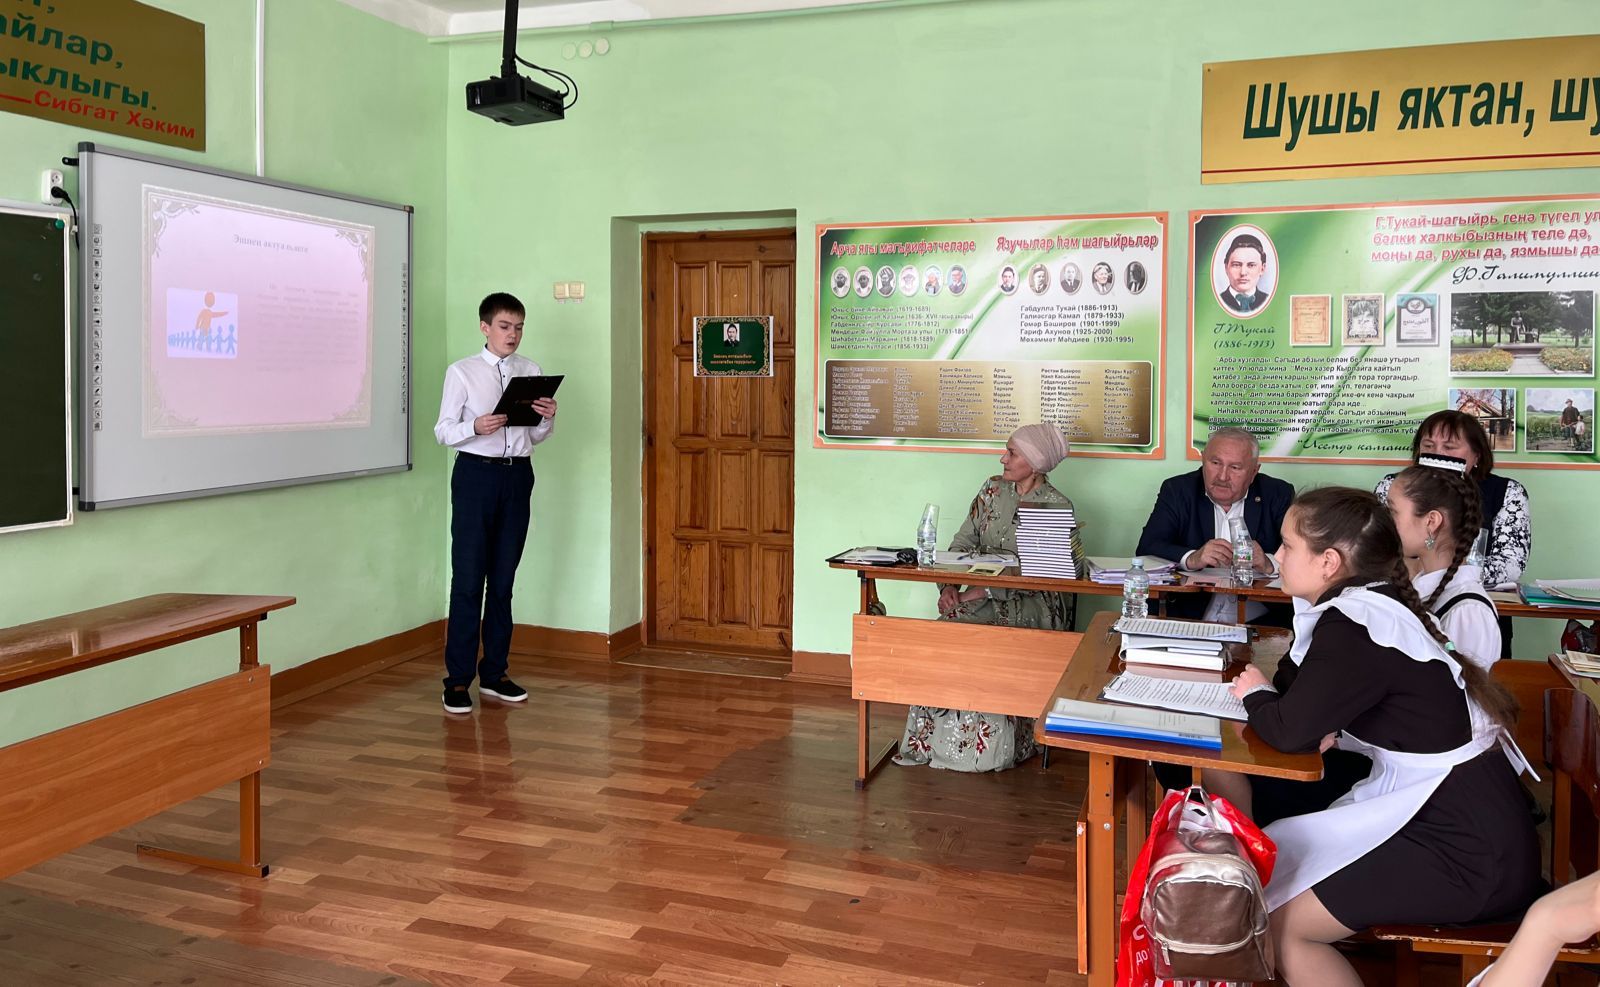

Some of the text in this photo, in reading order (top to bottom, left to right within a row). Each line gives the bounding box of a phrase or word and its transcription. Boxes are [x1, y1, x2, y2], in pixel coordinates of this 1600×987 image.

[34, 90, 196, 139] Сибгат Хәким
[1243, 81, 1380, 152] Шушы
[1397, 80, 1536, 138] яктан,
[1375, 212, 1498, 231] Г.Тукай-шагыйрь
[1503, 213, 1536, 225] генә
[1540, 211, 1581, 226] түгел
[1420, 229, 1528, 245] халкыбызның
[1531, 229, 1565, 241] теле
[1568, 228, 1592, 241] дә,
[830, 240, 857, 257] Арча
[858, 243, 878, 256] ягы
[996, 236, 1054, 255] Язучылар
[1056, 235, 1080, 250] һәм
[1371, 250, 1412, 263] моңы
[1415, 249, 1438, 262] да,
[1441, 248, 1480, 262] рухы
[1483, 247, 1507, 261] да,
[1510, 246, 1578, 257] язмышы
[1077, 304, 1118, 312] (1886-1913)
[1084, 312, 1125, 320] (1879-1933)
[1079, 320, 1121, 328] (1901-1999)
[1020, 328, 1043, 336] Гариф
[1213, 323, 1275, 337] Г.Тукай
[1093, 336, 1134, 344] (1930-1995)
[1213, 340, 1275, 349] (1886-1913)
[1374, 364, 1402, 372] кайтып
[1286, 390, 1310, 398] барып
[1385, 391, 1415, 399] чакрым
[1367, 409, 1407, 417] абзыйның
[1301, 426, 1326, 434] булган
[1376, 426, 1399, 434] салам
